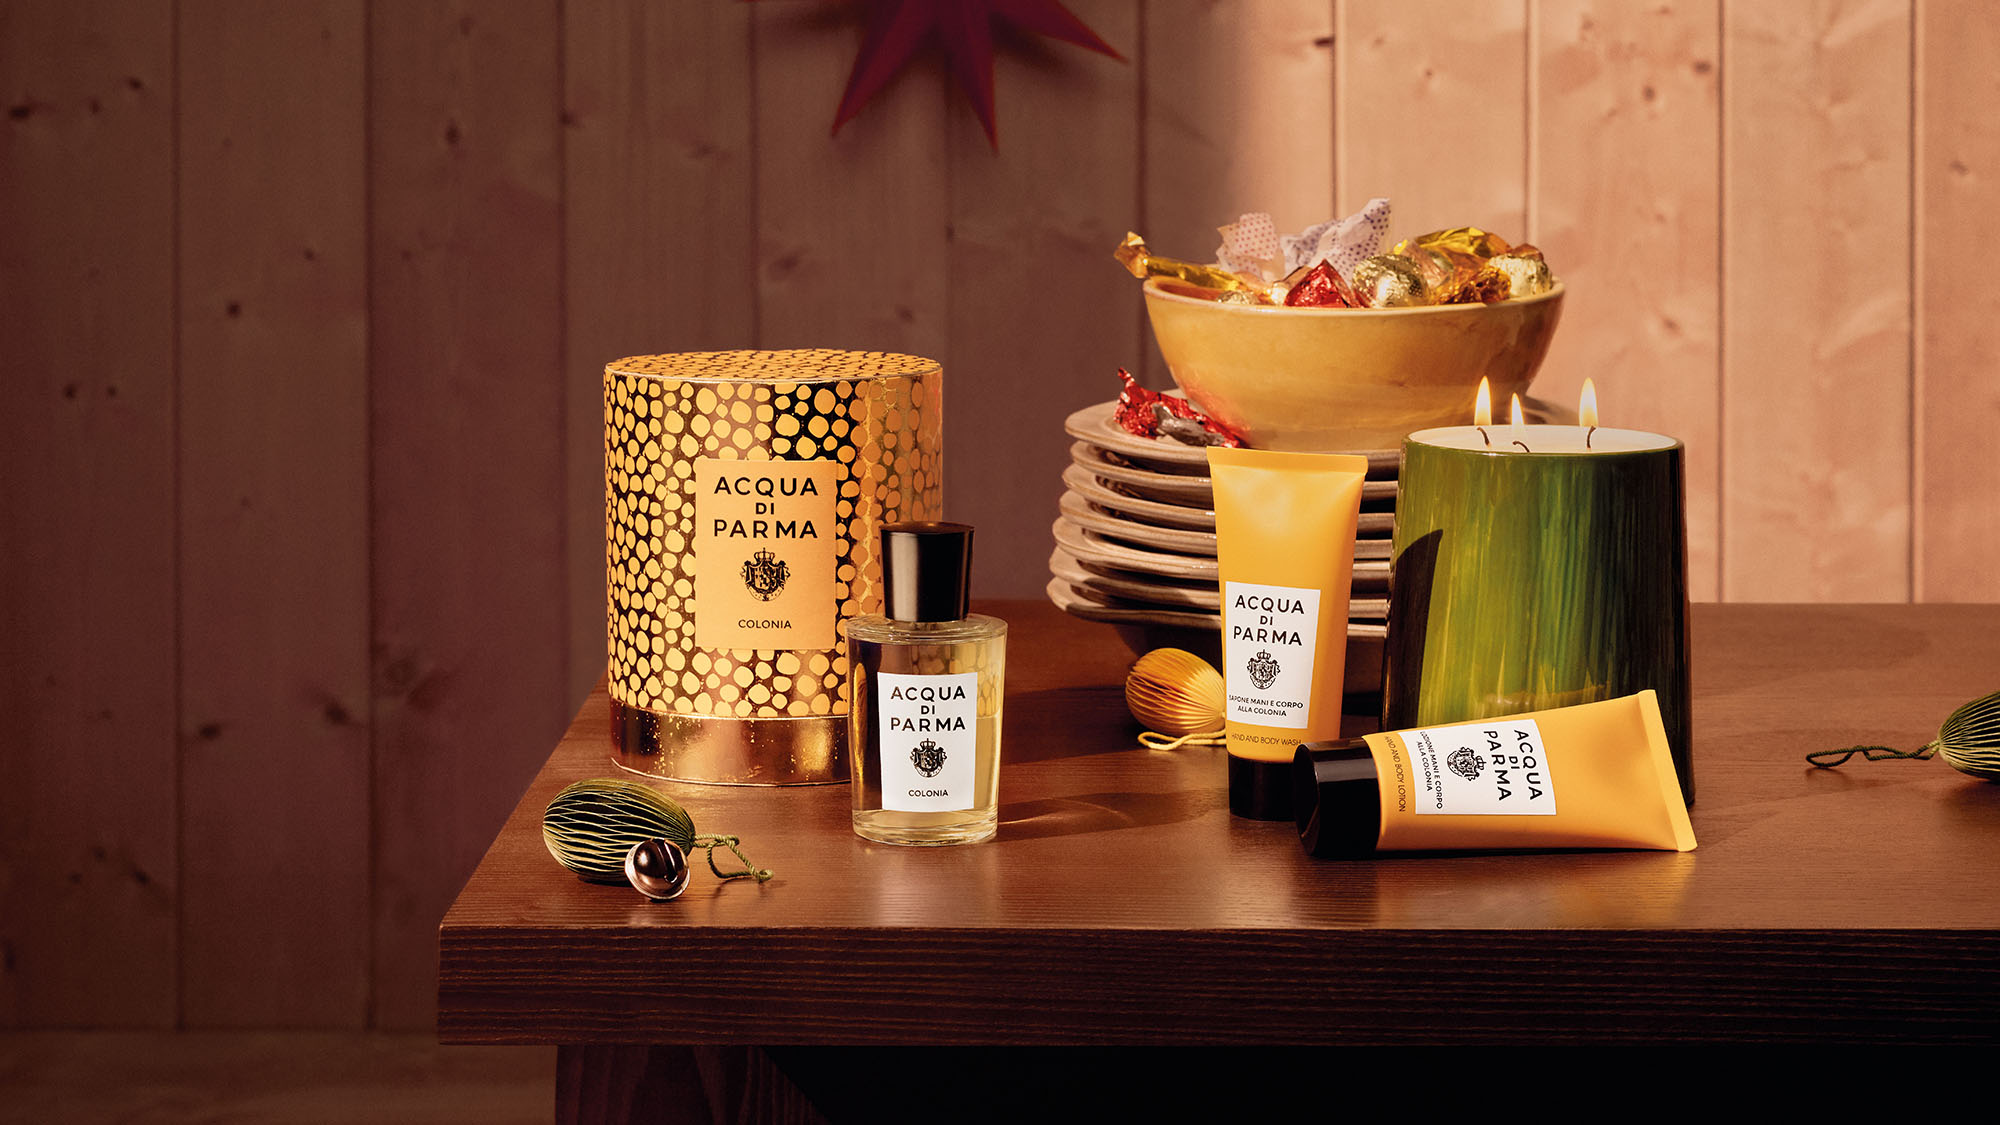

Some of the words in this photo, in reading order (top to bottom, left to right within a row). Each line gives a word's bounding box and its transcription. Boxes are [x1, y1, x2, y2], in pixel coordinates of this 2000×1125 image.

[714, 476, 818, 498] ACQUA
[755, 502, 775, 515] DI
[714, 519, 818, 539] PARMA
[1235, 594, 1304, 615] ACQUA
[738, 619, 792, 629] COLONIA
[1259, 615, 1273, 626] DI
[1233, 625, 1302, 646] PARMA
[890, 685, 966, 702] ACQUA
[1228, 694, 1249, 704] SAPONE
[1250, 698, 1268, 706] MANI
[1275, 700, 1304, 709] CORPO
[920, 705, 935, 715] DI
[1237, 705, 1253, 713] ALLA
[1253, 707, 1287, 717] COLONIA
[890, 717, 966, 732] PARMA
[1245, 735, 1259, 743] AND
[1260, 736, 1280, 745] BODY
[1281, 738, 1302, 746] WASH
[1390, 749, 1401, 763] AND
[1417, 741, 1426, 757] ALLA
[1483, 730, 1512, 801] PARMA
[1508, 756, 1520, 770] DI
[1513, 729, 1543, 800] ACQUA
[1394, 763, 1405, 783] BODY
[1421, 757, 1433, 792] COLONIA
[1430, 754, 1440, 773] MANI
[1435, 780, 1443, 810] CORPO
[908, 789, 949, 797] COLONIA
[1397, 784, 1406, 812] LOTION
